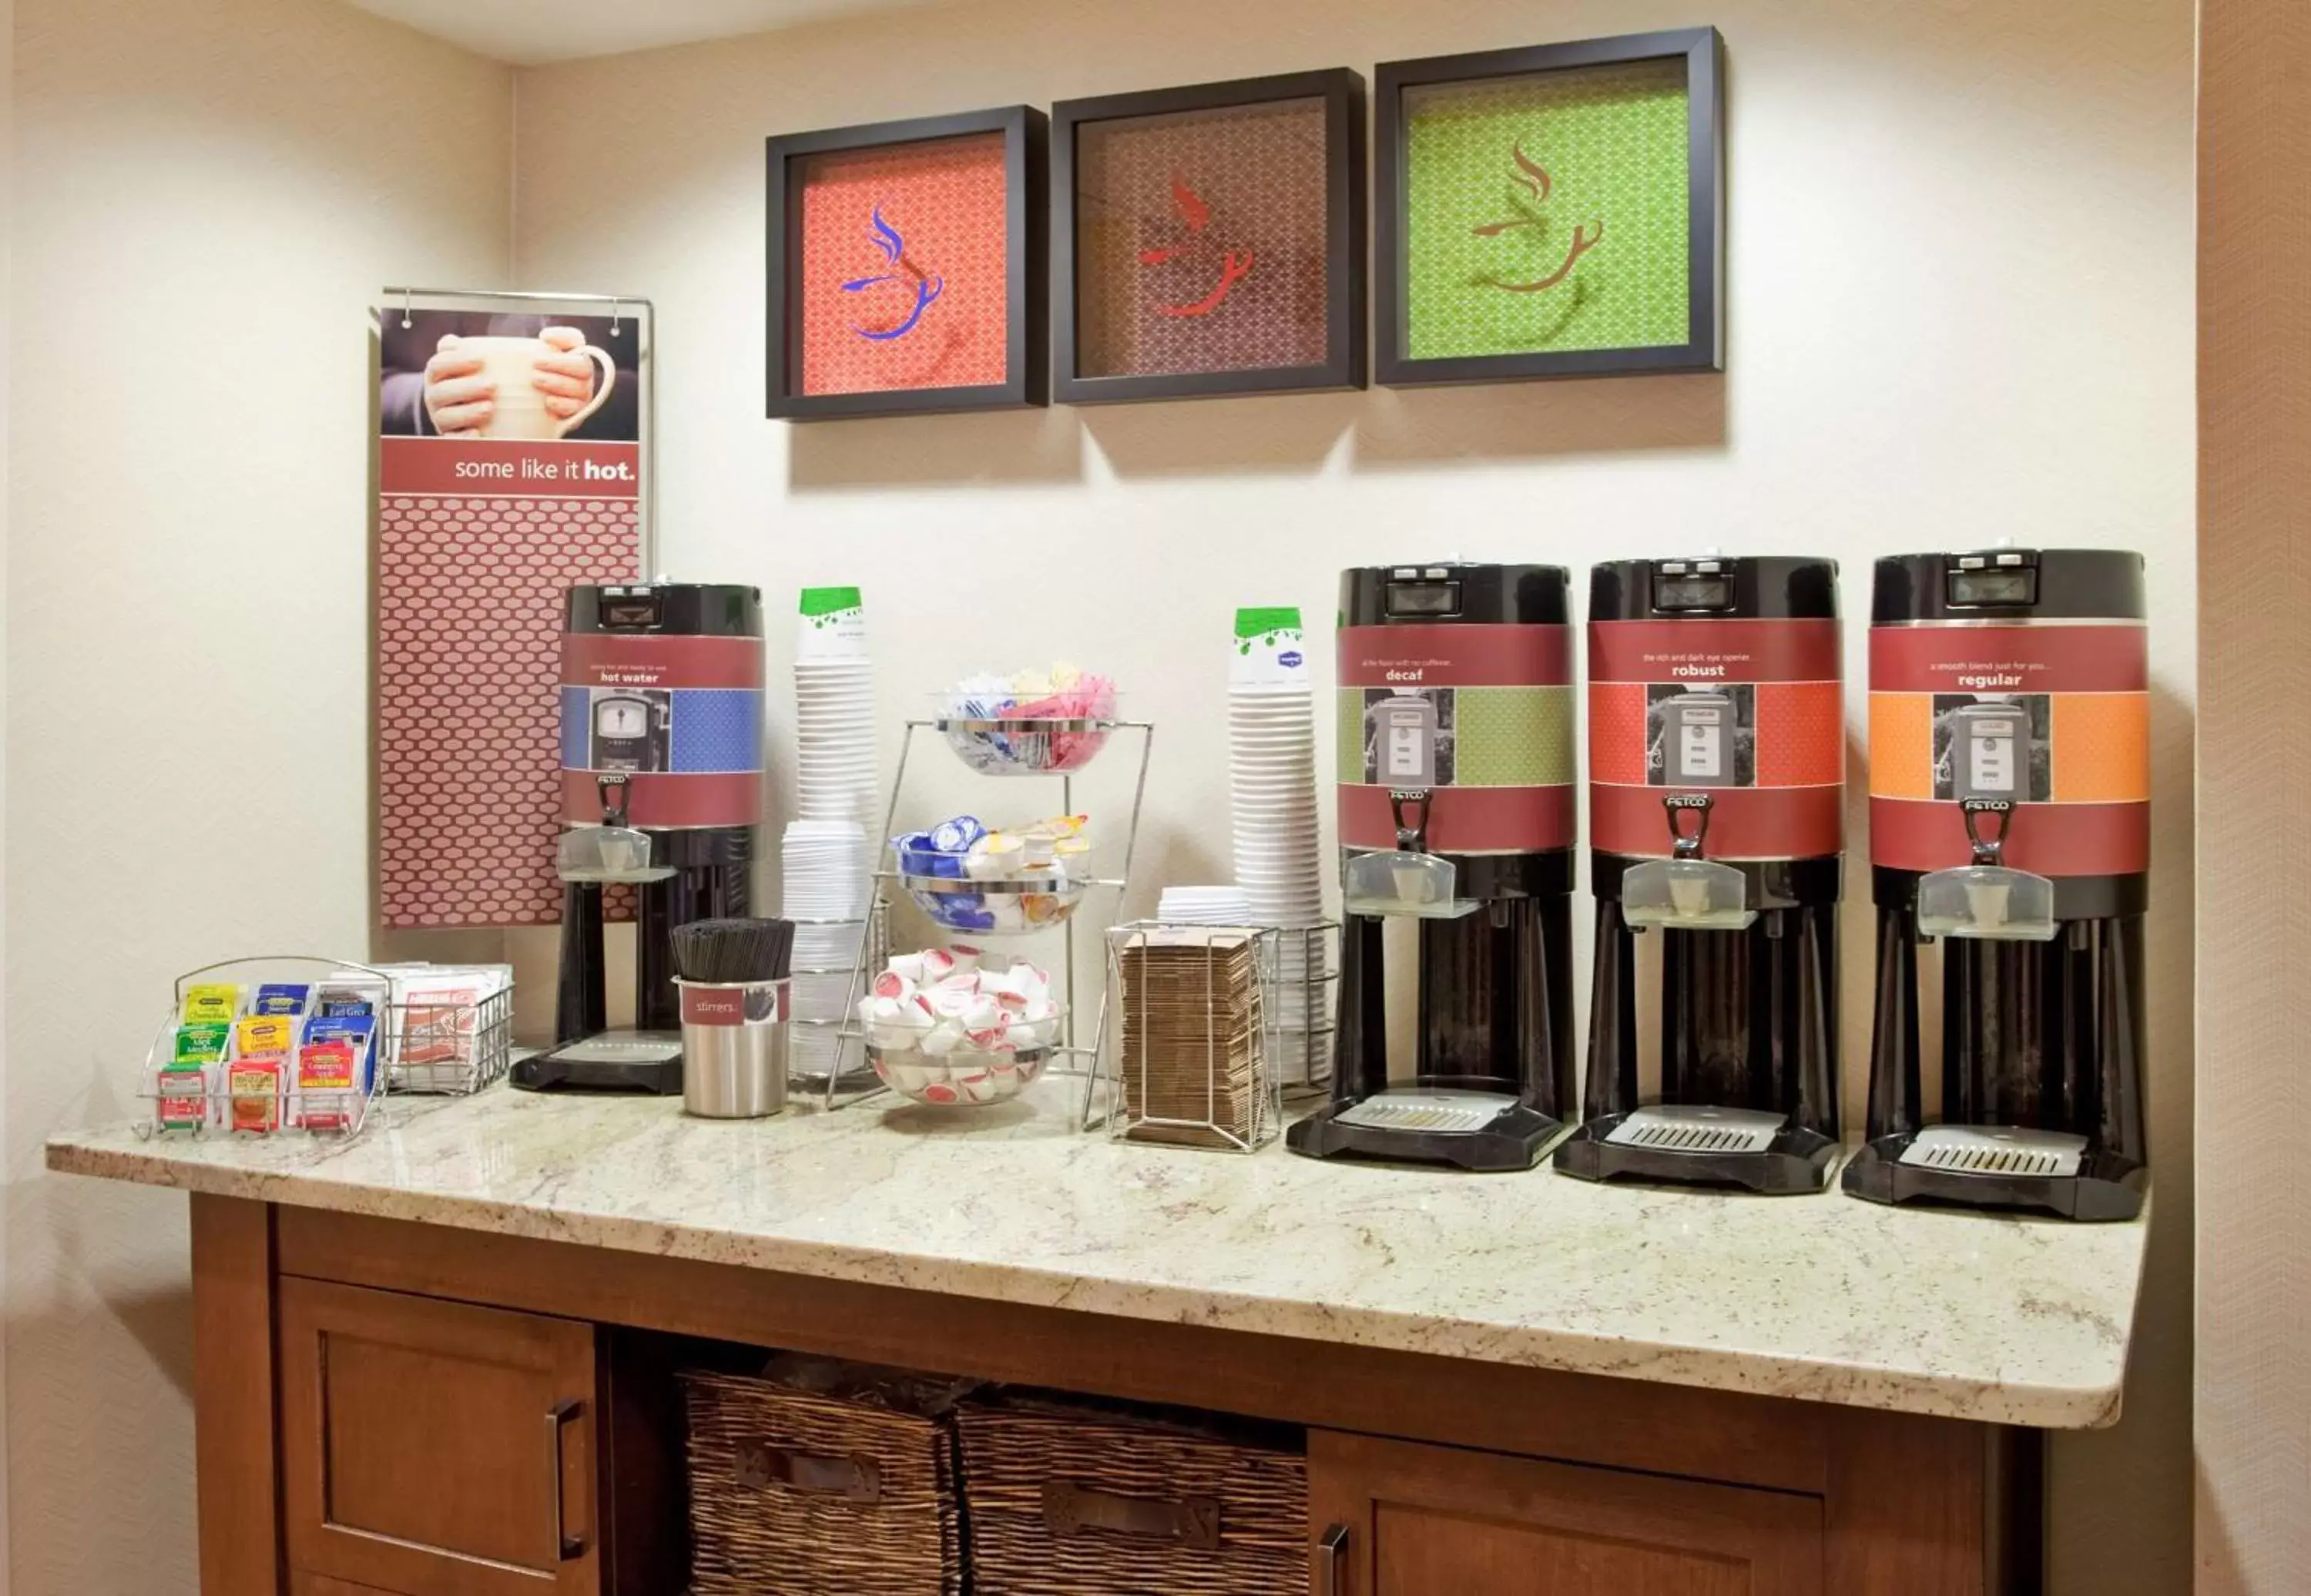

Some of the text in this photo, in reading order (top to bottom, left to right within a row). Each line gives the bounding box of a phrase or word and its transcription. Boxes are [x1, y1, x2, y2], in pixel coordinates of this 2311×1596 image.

[455, 458, 636, 481] some like it hot.
[1386, 669, 1423, 680] decaf
[1672, 663, 1726, 676] robust
[600, 671, 659, 683] hot water
[1958, 672, 2022, 689] regular
[1666, 796, 1707, 807] FETCO
[1965, 800, 2010, 810] FETCO
